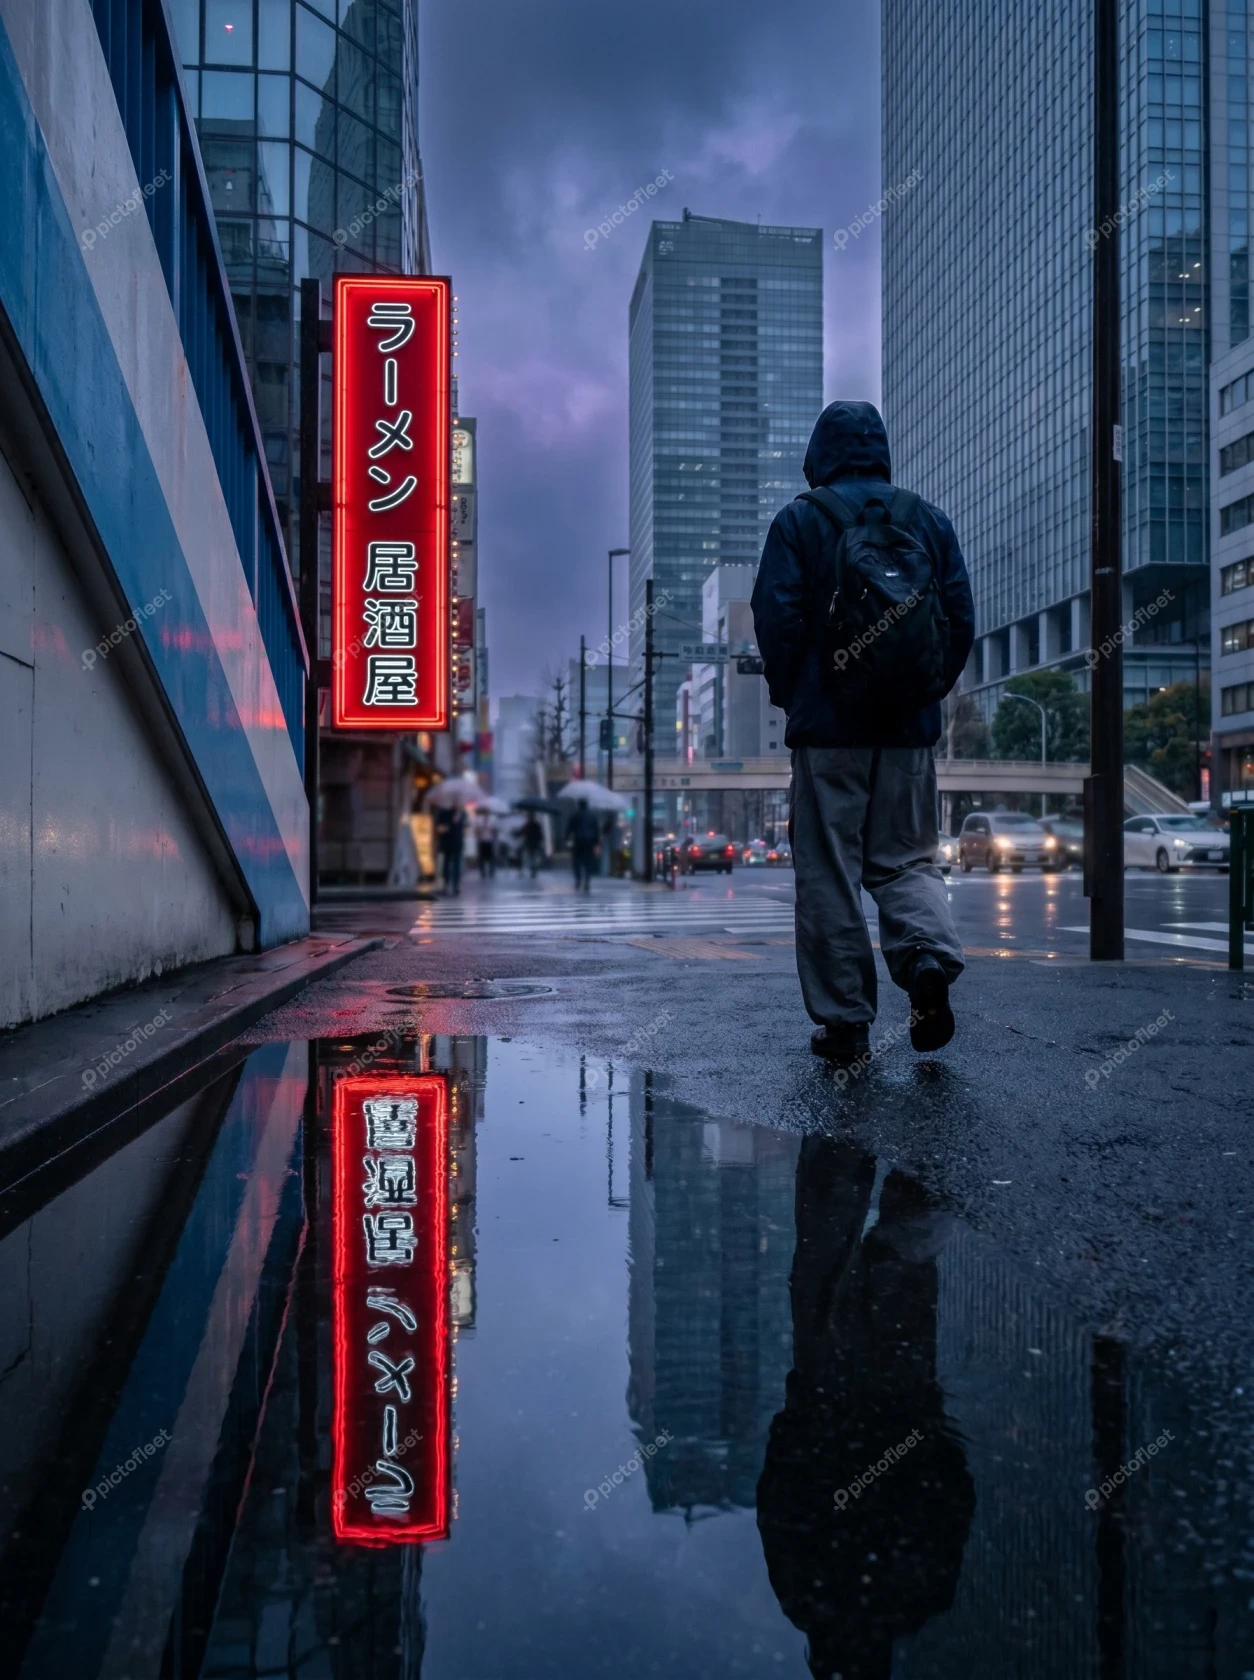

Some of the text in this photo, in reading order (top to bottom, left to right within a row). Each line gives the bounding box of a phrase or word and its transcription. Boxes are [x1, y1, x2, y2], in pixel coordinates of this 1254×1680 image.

[363, 302, 419, 706] ラーメン 居酒屋
